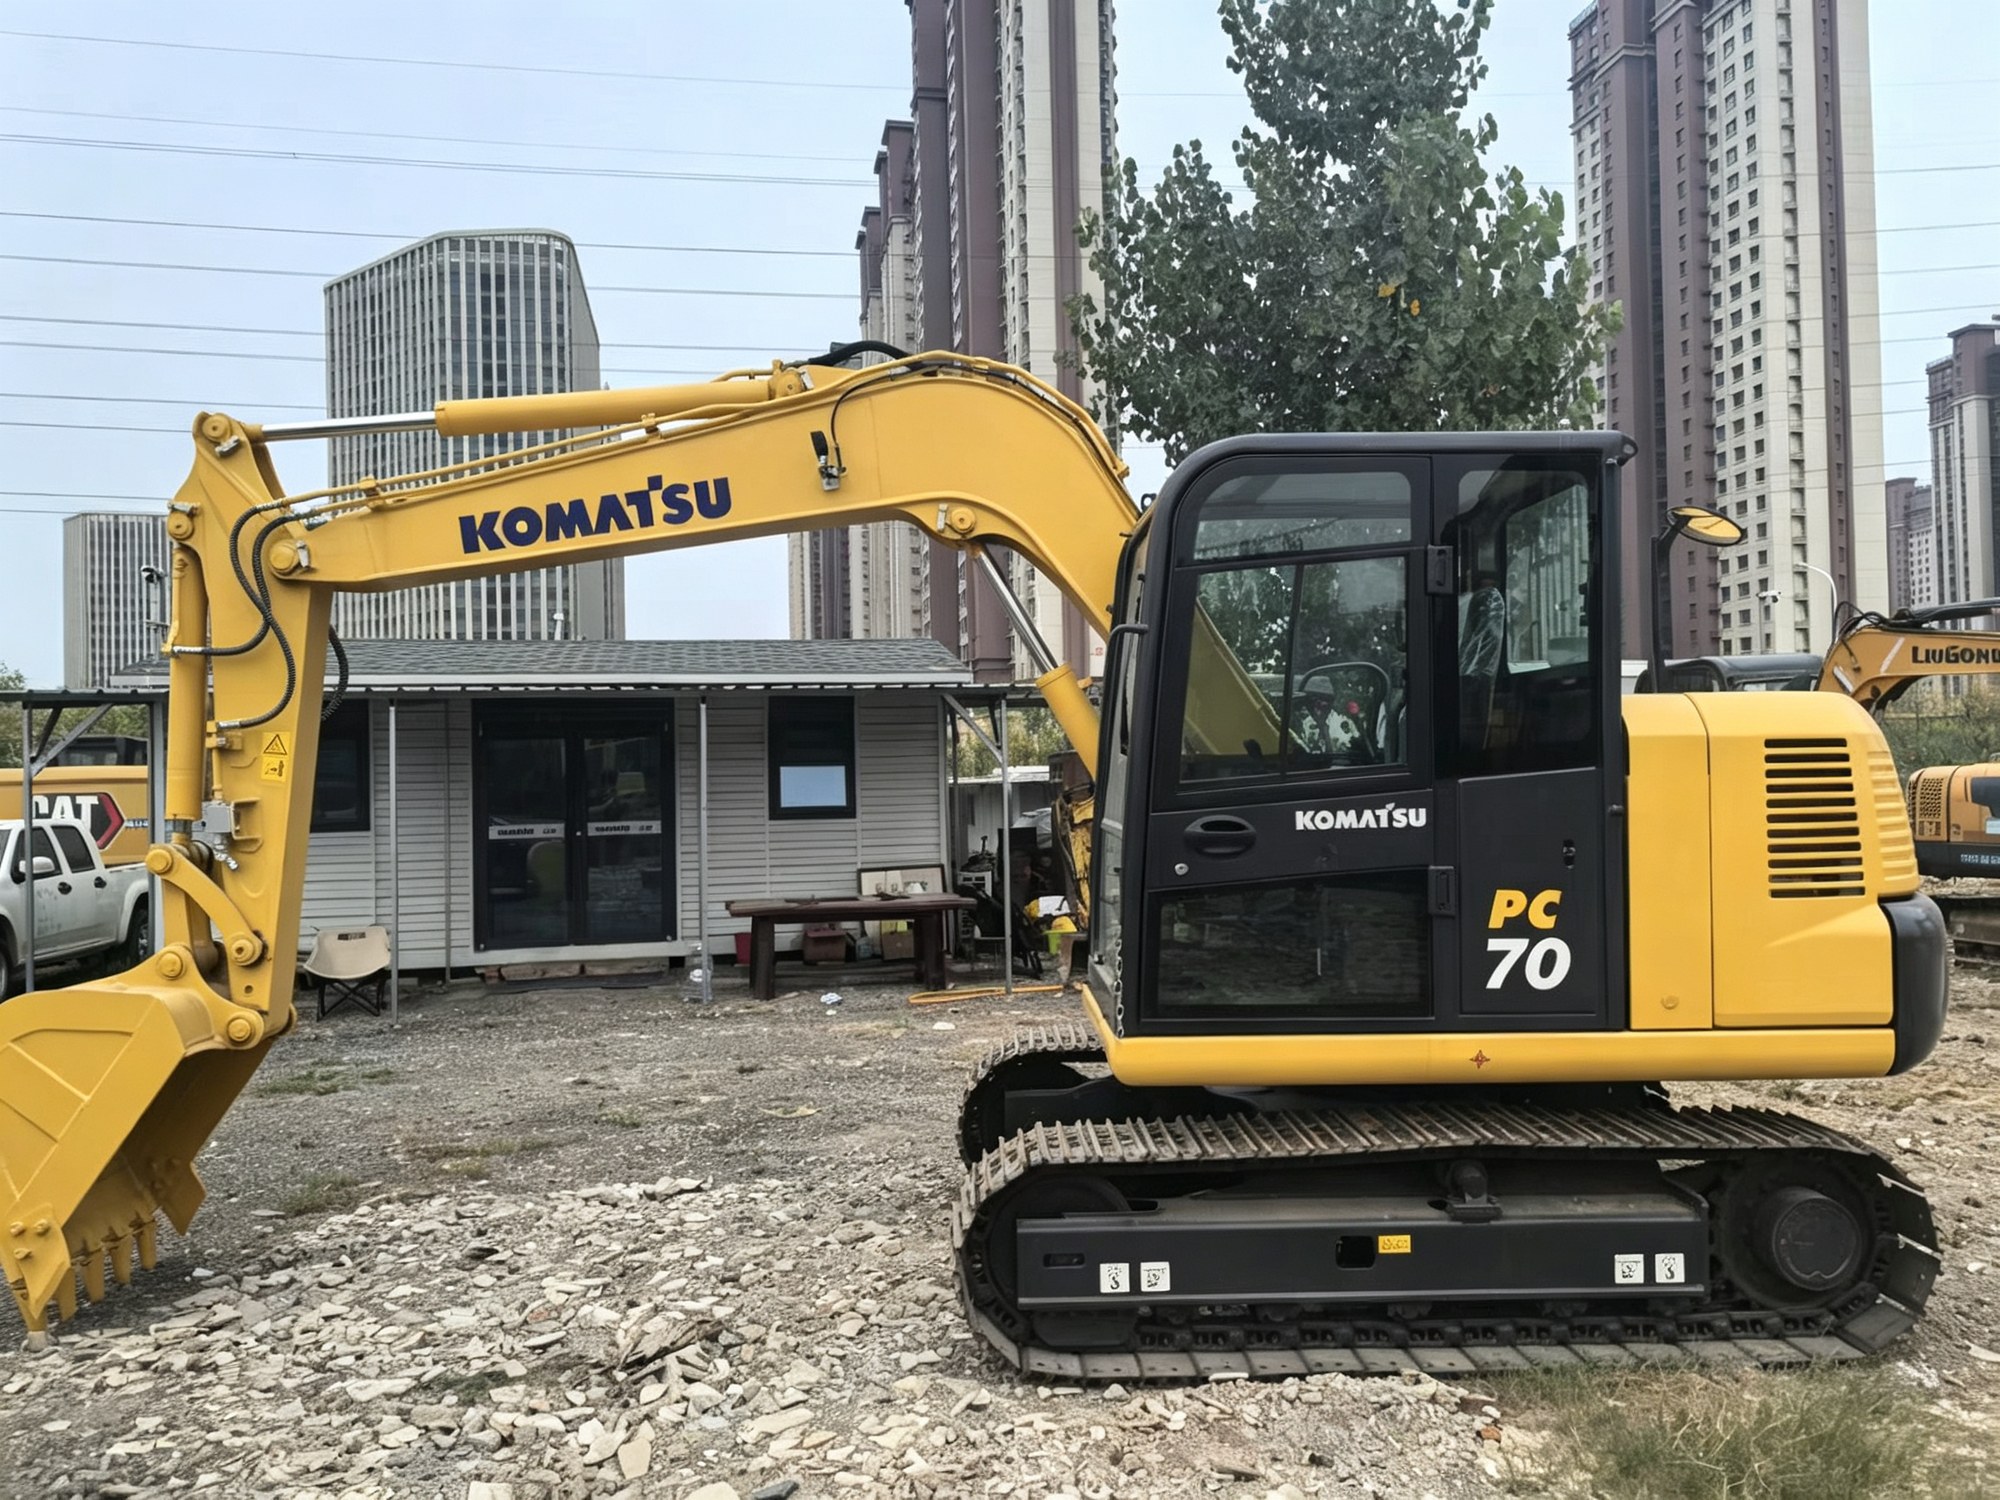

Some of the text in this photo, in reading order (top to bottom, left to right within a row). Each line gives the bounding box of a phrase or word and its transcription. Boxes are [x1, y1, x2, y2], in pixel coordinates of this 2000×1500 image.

[459, 475, 732, 554] KOMATSU
[1295, 802, 1427, 830] KOMATSU
[1488, 889, 1562, 929] PC
[1485, 937, 1571, 990] 70
